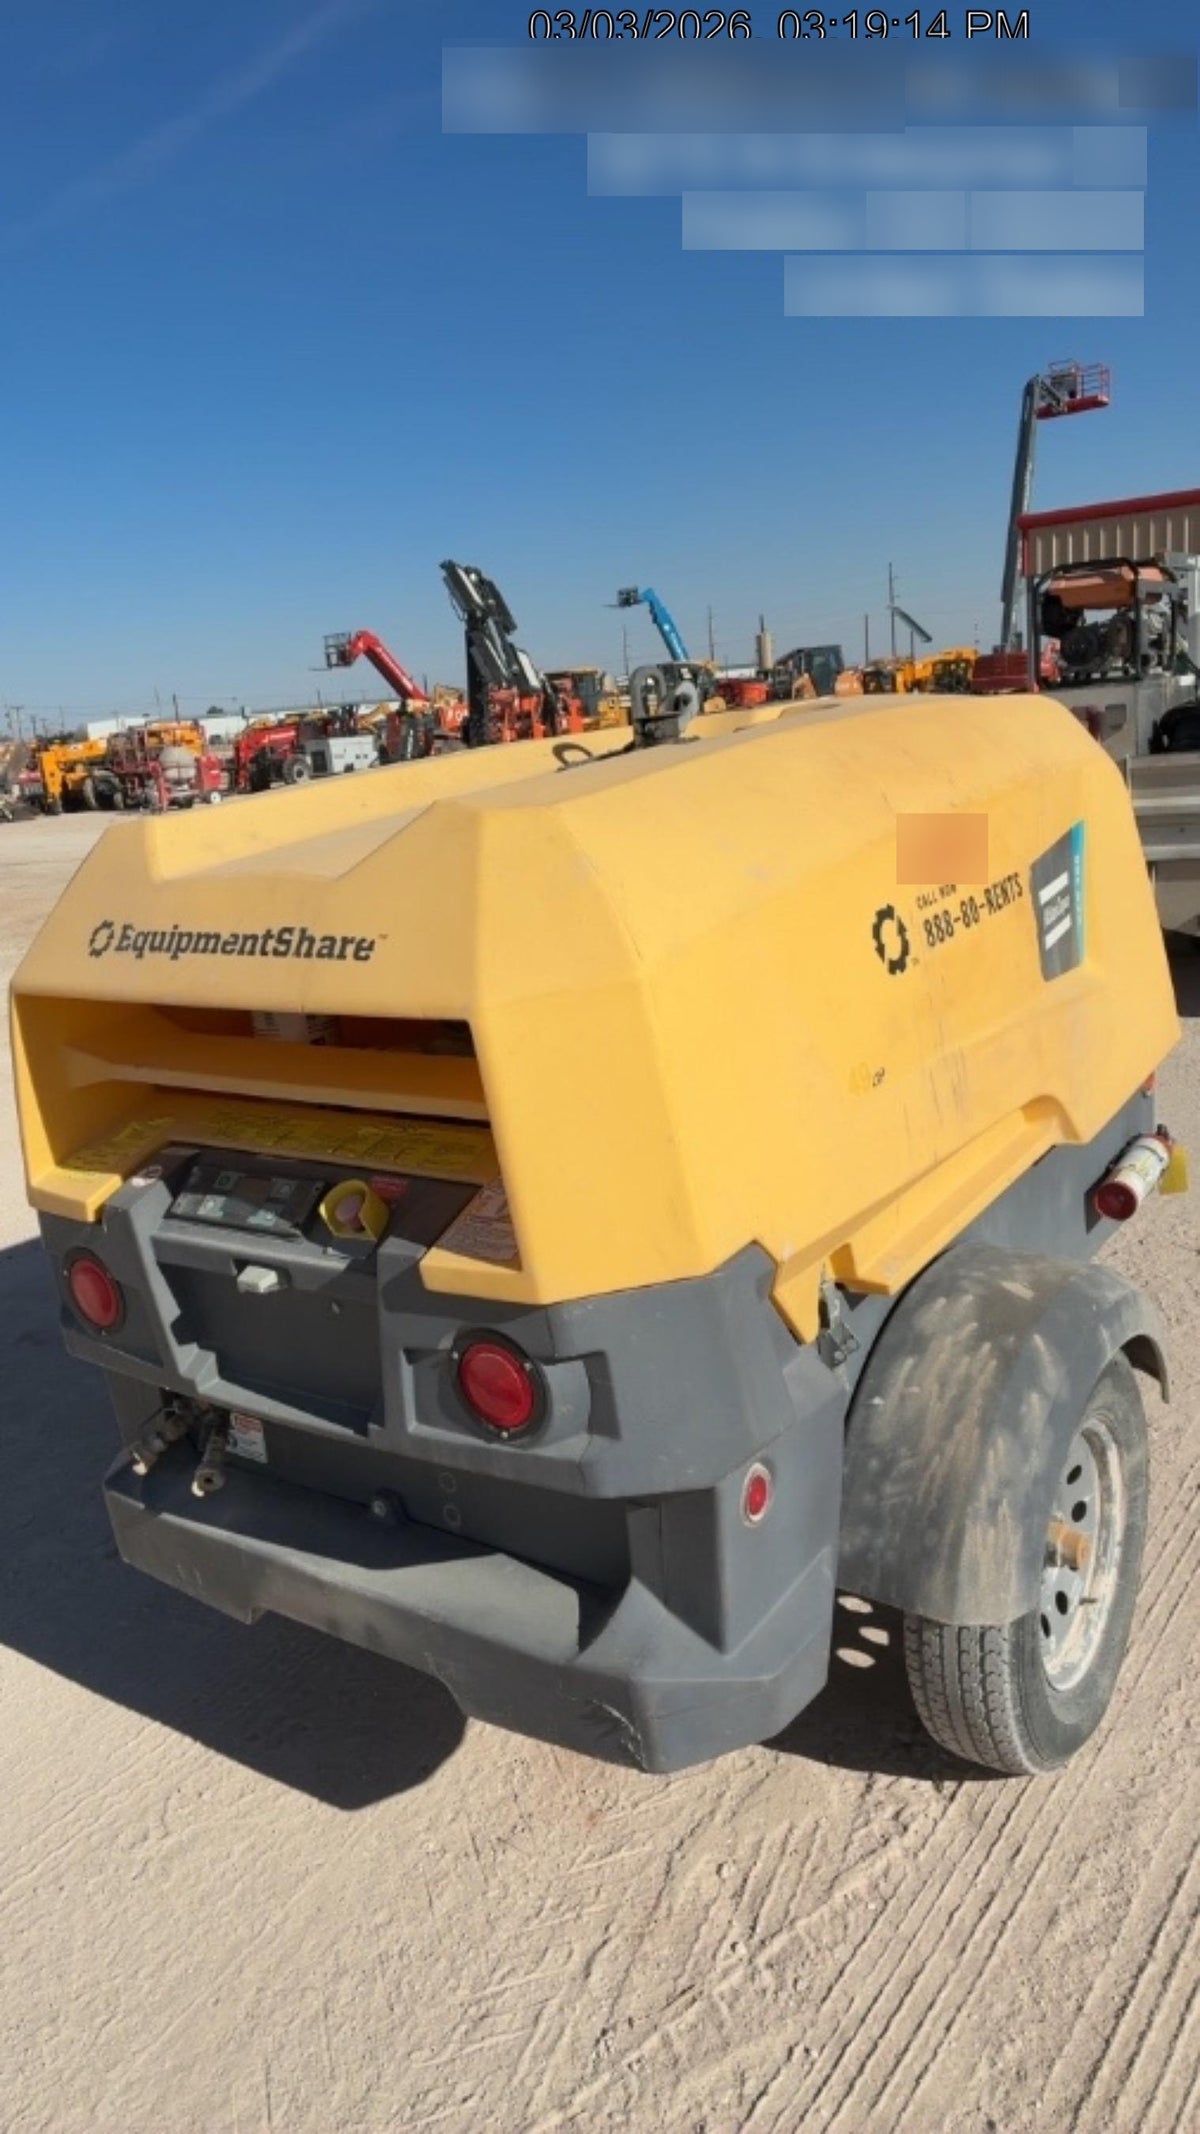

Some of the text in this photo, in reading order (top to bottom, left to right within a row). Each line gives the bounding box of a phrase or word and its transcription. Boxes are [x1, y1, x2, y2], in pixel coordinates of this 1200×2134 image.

[916, 890, 938, 910] CALL
[923, 872, 1023, 948] 888-80-RENTS
[114, 923, 376, 961] EquipmentShare
